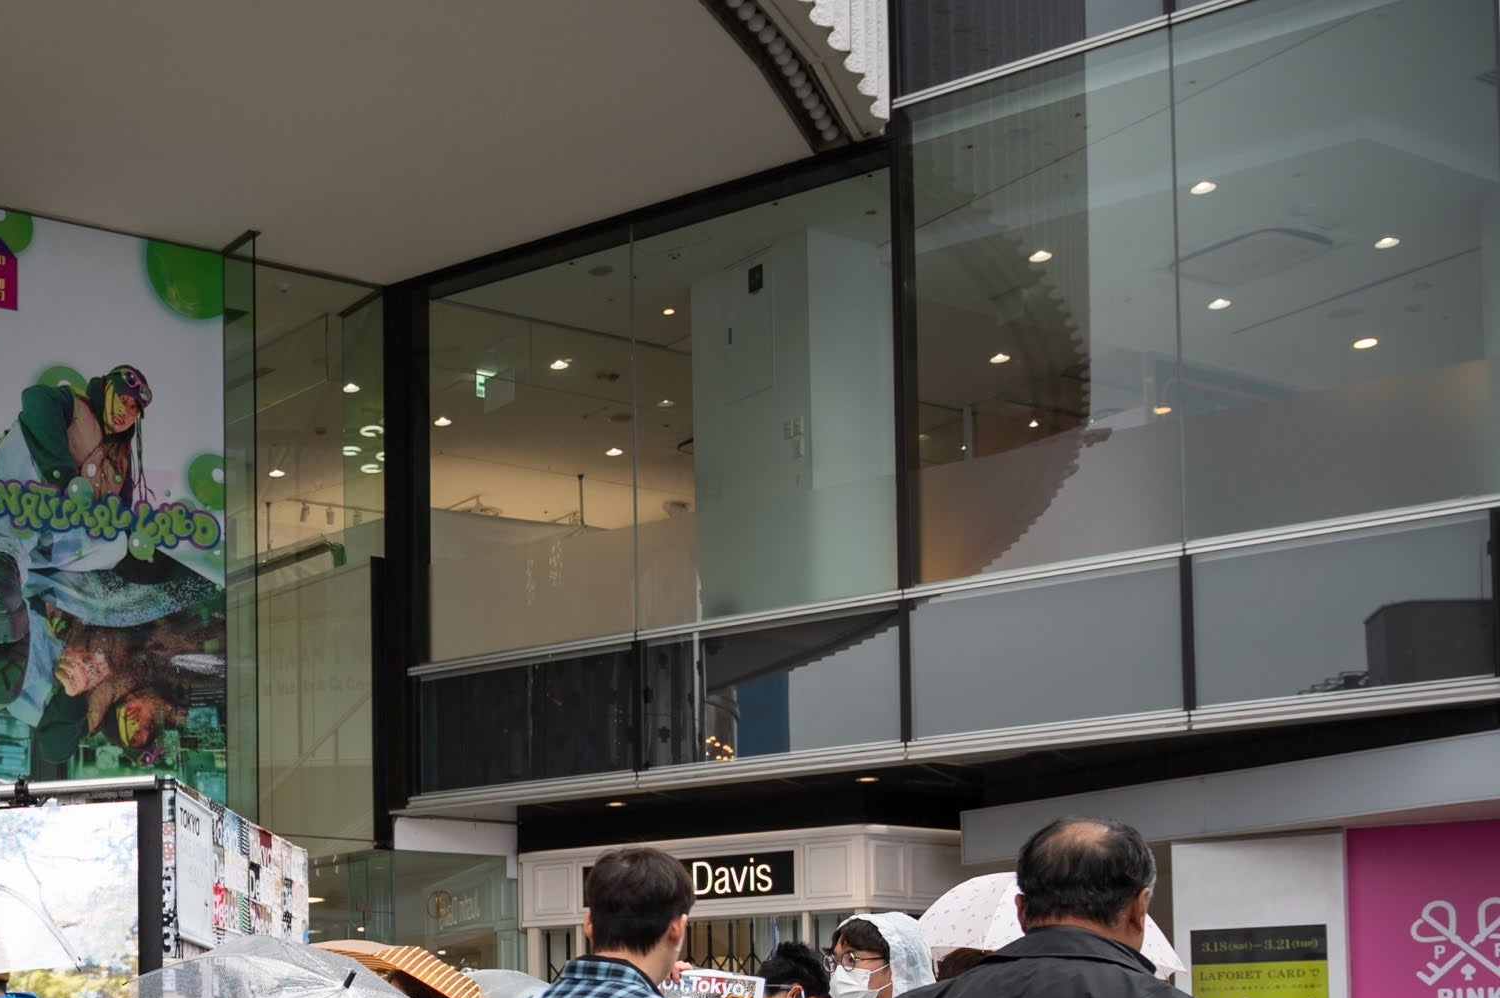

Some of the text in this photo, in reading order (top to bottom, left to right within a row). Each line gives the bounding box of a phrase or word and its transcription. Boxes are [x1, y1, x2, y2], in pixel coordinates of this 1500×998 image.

[180, 807, 200, 837] TOKYO
[693, 857, 773, 895] Davis
[1200, 970, 1262, 981] LAFORET
[1267, 968, 1305, 979] CARD
